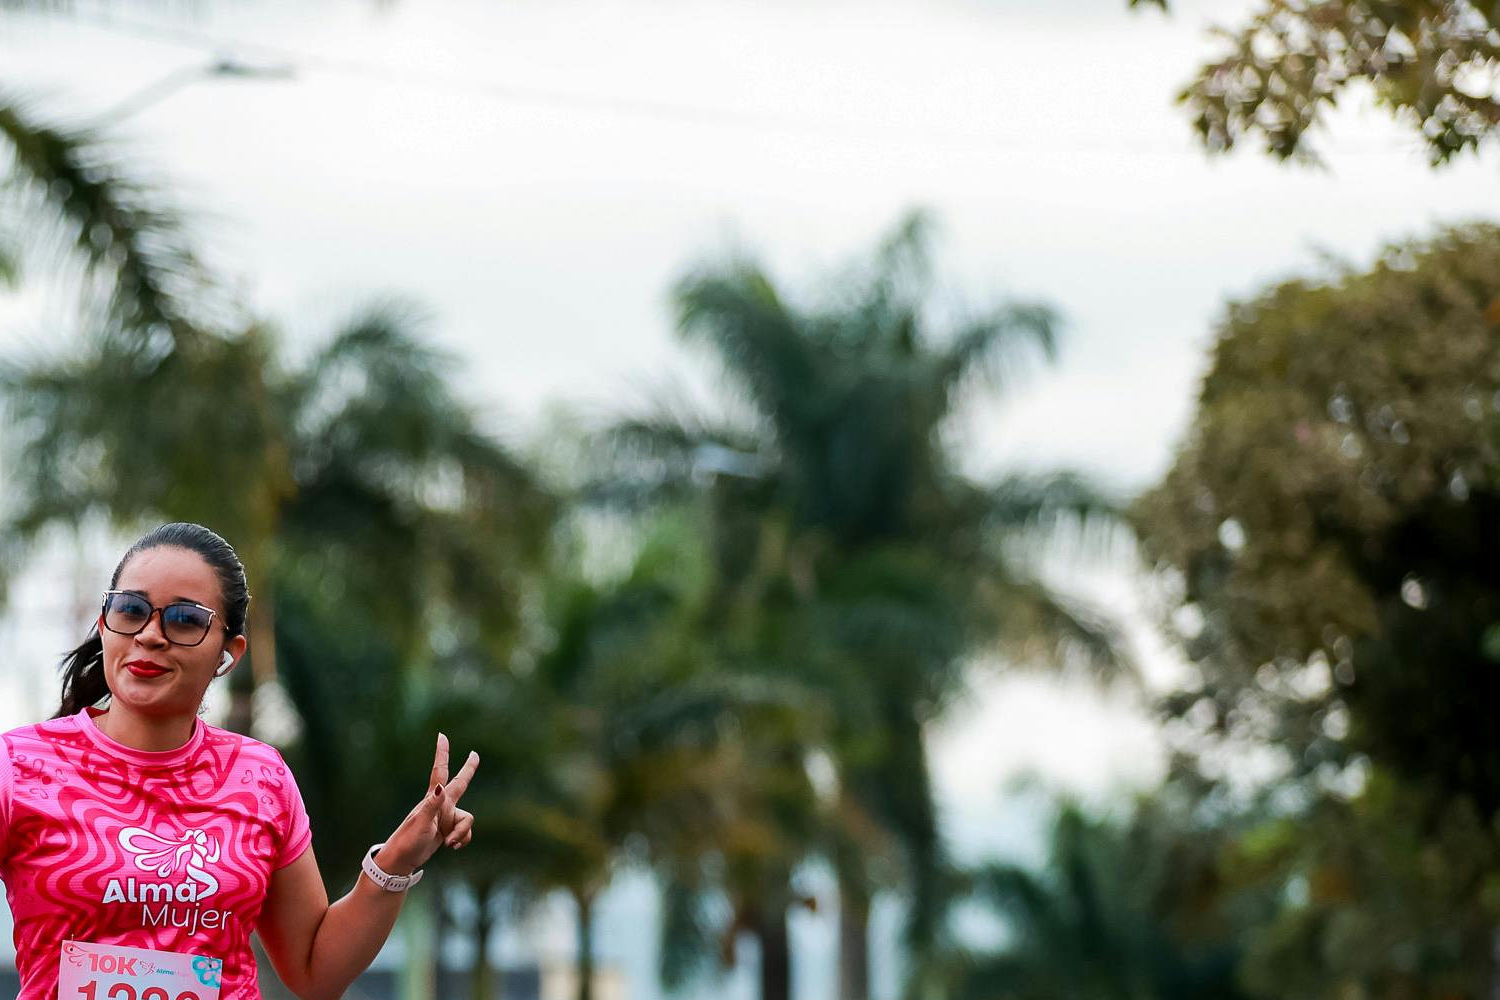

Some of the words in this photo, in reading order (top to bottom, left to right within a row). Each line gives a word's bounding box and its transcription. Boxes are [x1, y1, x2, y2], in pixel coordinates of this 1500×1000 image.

[102, 877, 198, 904] Alma
[142, 902, 232, 936] Mujer
[88, 953, 138, 977] 10K
